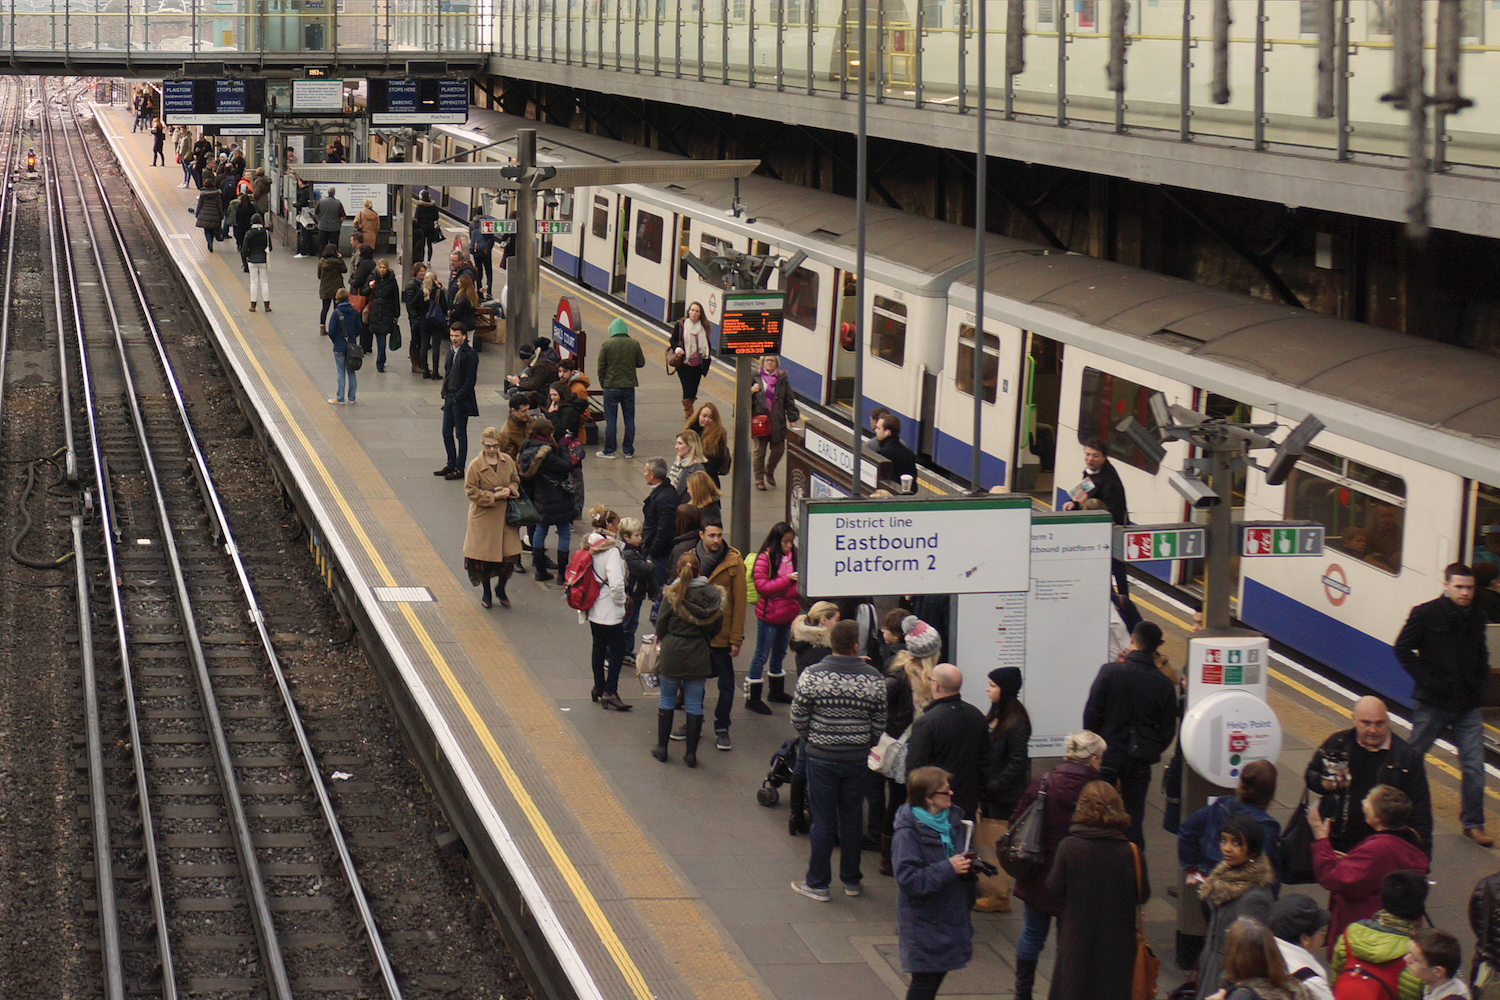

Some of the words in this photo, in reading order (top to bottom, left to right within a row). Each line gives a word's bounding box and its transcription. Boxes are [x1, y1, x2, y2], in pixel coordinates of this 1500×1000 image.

[840, 452, 855, 471] COU
[836, 517, 885, 528] District
[889, 517, 913, 528] line
[835, 533, 938, 551] Eastbound
[835, 557, 919, 576] platform
[927, 555, 936, 570] 2
[1227, 721, 1248, 730] Help
